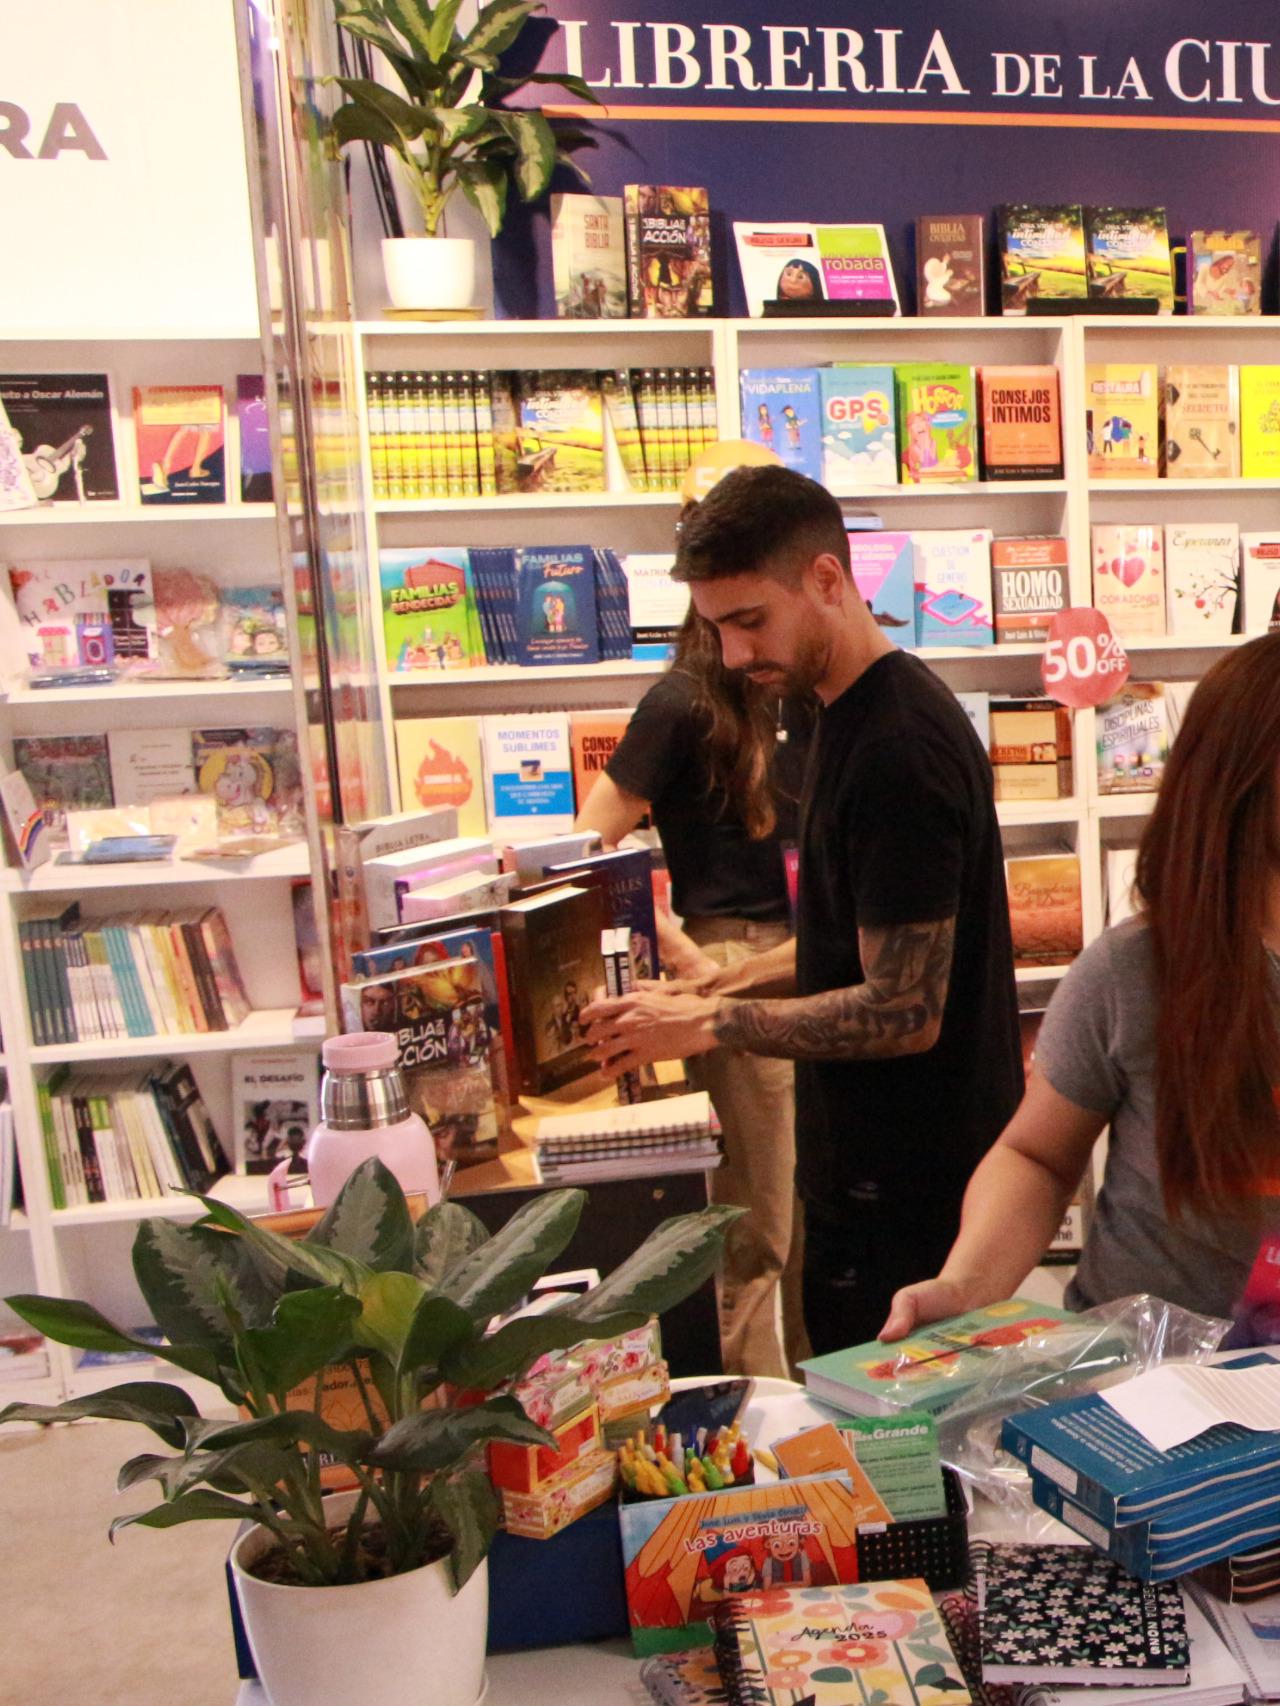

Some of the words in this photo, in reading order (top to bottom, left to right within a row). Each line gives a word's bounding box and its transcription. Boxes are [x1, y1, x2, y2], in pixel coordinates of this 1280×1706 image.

[558, 19, 971, 95] LIBRERIA
[991, 52, 1064, 99] DE
[1079, 54, 1154, 101] LA
[643, 229, 687, 245] ACCIÓN
[824, 256, 884, 272] robada
[991, 388, 1051, 405] CONSEJOS
[828, 398, 884, 423] GPS
[991, 404, 1052, 424] INTIMOS
[521, 553, 584, 565] FAMILIAS
[390, 581, 458, 602] FAMILIAS
[1000, 570, 1062, 598] HOMO
[1002, 595, 1064, 611] SEXUALIDAD
[1045, 633, 1127, 683] 50%
[1097, 658, 1125, 674] OFF
[1103, 701, 1154, 733] DISCIPLINAS
[498, 728, 560, 741] MOMENTOS
[1102, 715, 1160, 750] ESPIRITUALES
[502, 740, 558, 753] SUBLIMES
[397, 1024, 438, 1046] BLIA
[397, 1037, 449, 1068] CIÓN
[873, 1424, 929, 1440] Grande
[684, 1533, 716, 1554] Las
[724, 1519, 823, 1543] aventuras
[1142, 1586, 1157, 1618] GENDA
[790, 1621, 874, 1643] Agenda
[834, 1630, 888, 1642] 2025
